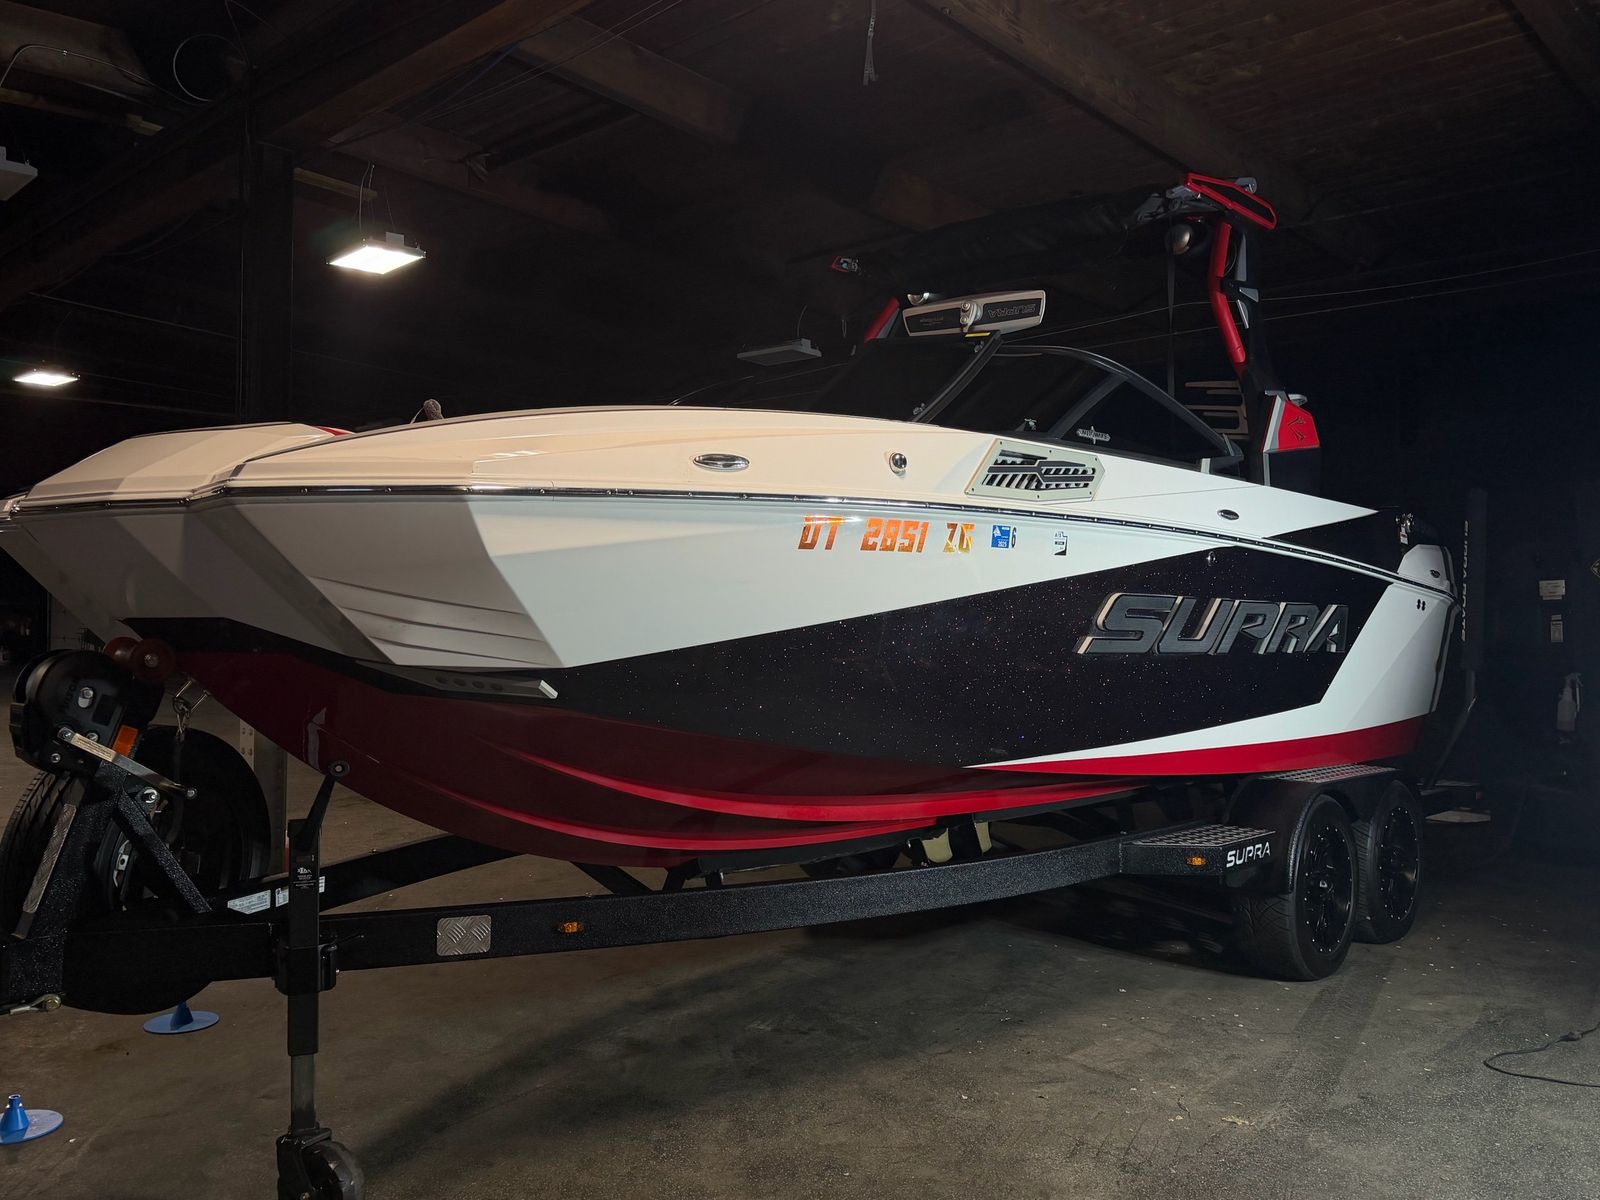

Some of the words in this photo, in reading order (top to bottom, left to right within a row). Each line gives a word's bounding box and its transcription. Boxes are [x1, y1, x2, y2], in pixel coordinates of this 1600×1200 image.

[798, 516, 844, 550] UT
[860, 518, 929, 553] 2851
[1076, 592, 1350, 654] SUPRA
[1226, 841, 1271, 868] SUPRA
